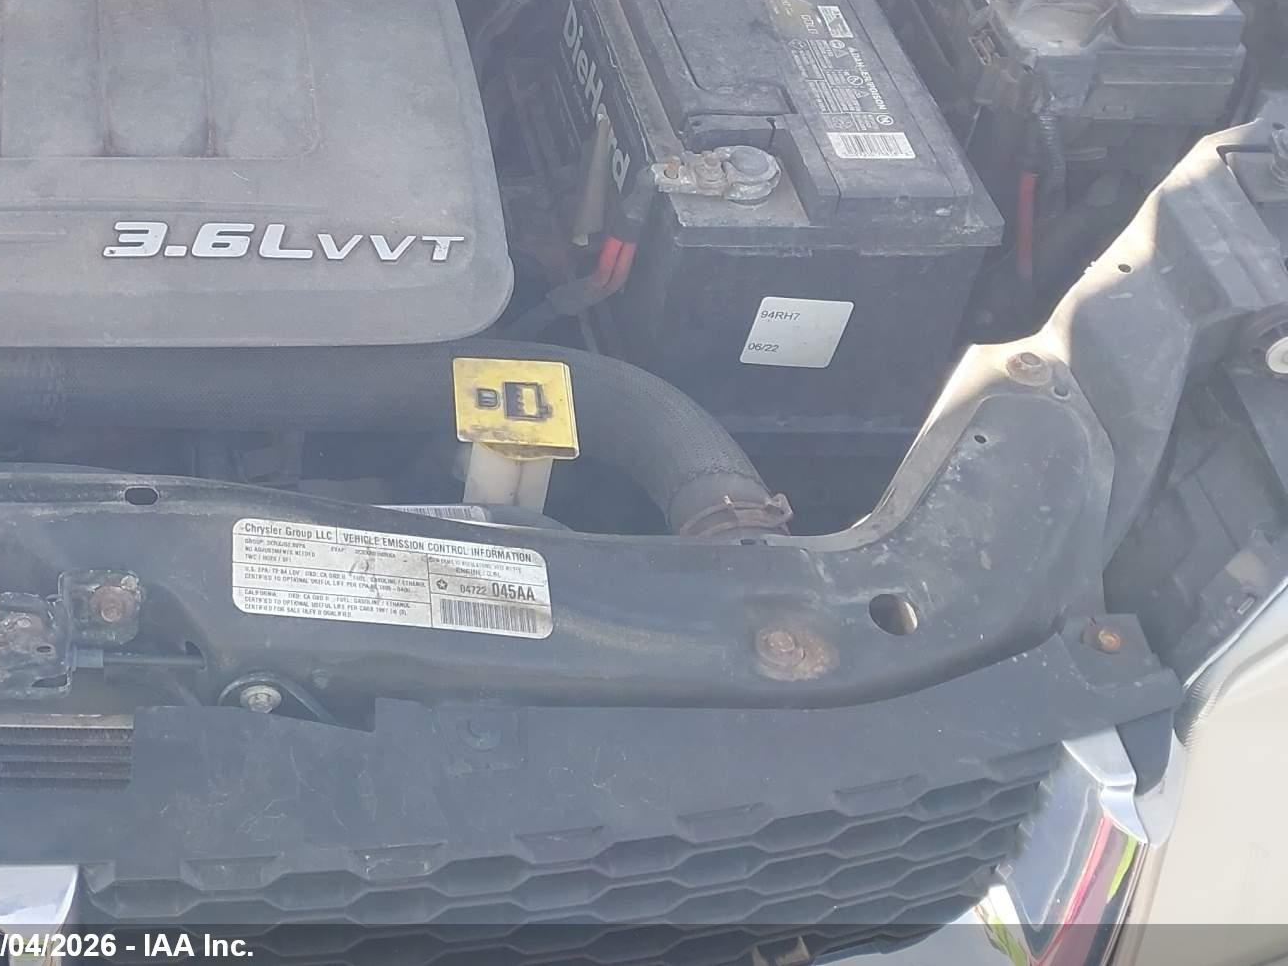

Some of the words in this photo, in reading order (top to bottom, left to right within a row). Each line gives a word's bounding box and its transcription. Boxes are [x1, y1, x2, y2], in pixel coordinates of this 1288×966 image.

[852, 53, 888, 111] DANER/POISON
[760, 310, 801, 321] 94RH7
[748, 342, 779, 353] 06/22
[245, 522, 282, 536] Chrysler
[285, 526, 312, 540] Group
[315, 529, 333, 540] LLC
[342, 532, 380, 547] VEHICLE
[382, 536, 425, 550] EMISSION
[427, 542, 469, 556] CONTROL
[471, 547, 532, 563] INFORMATION
[459, 584, 488, 595] 04722
[492, 582, 536, 601] 045AA
